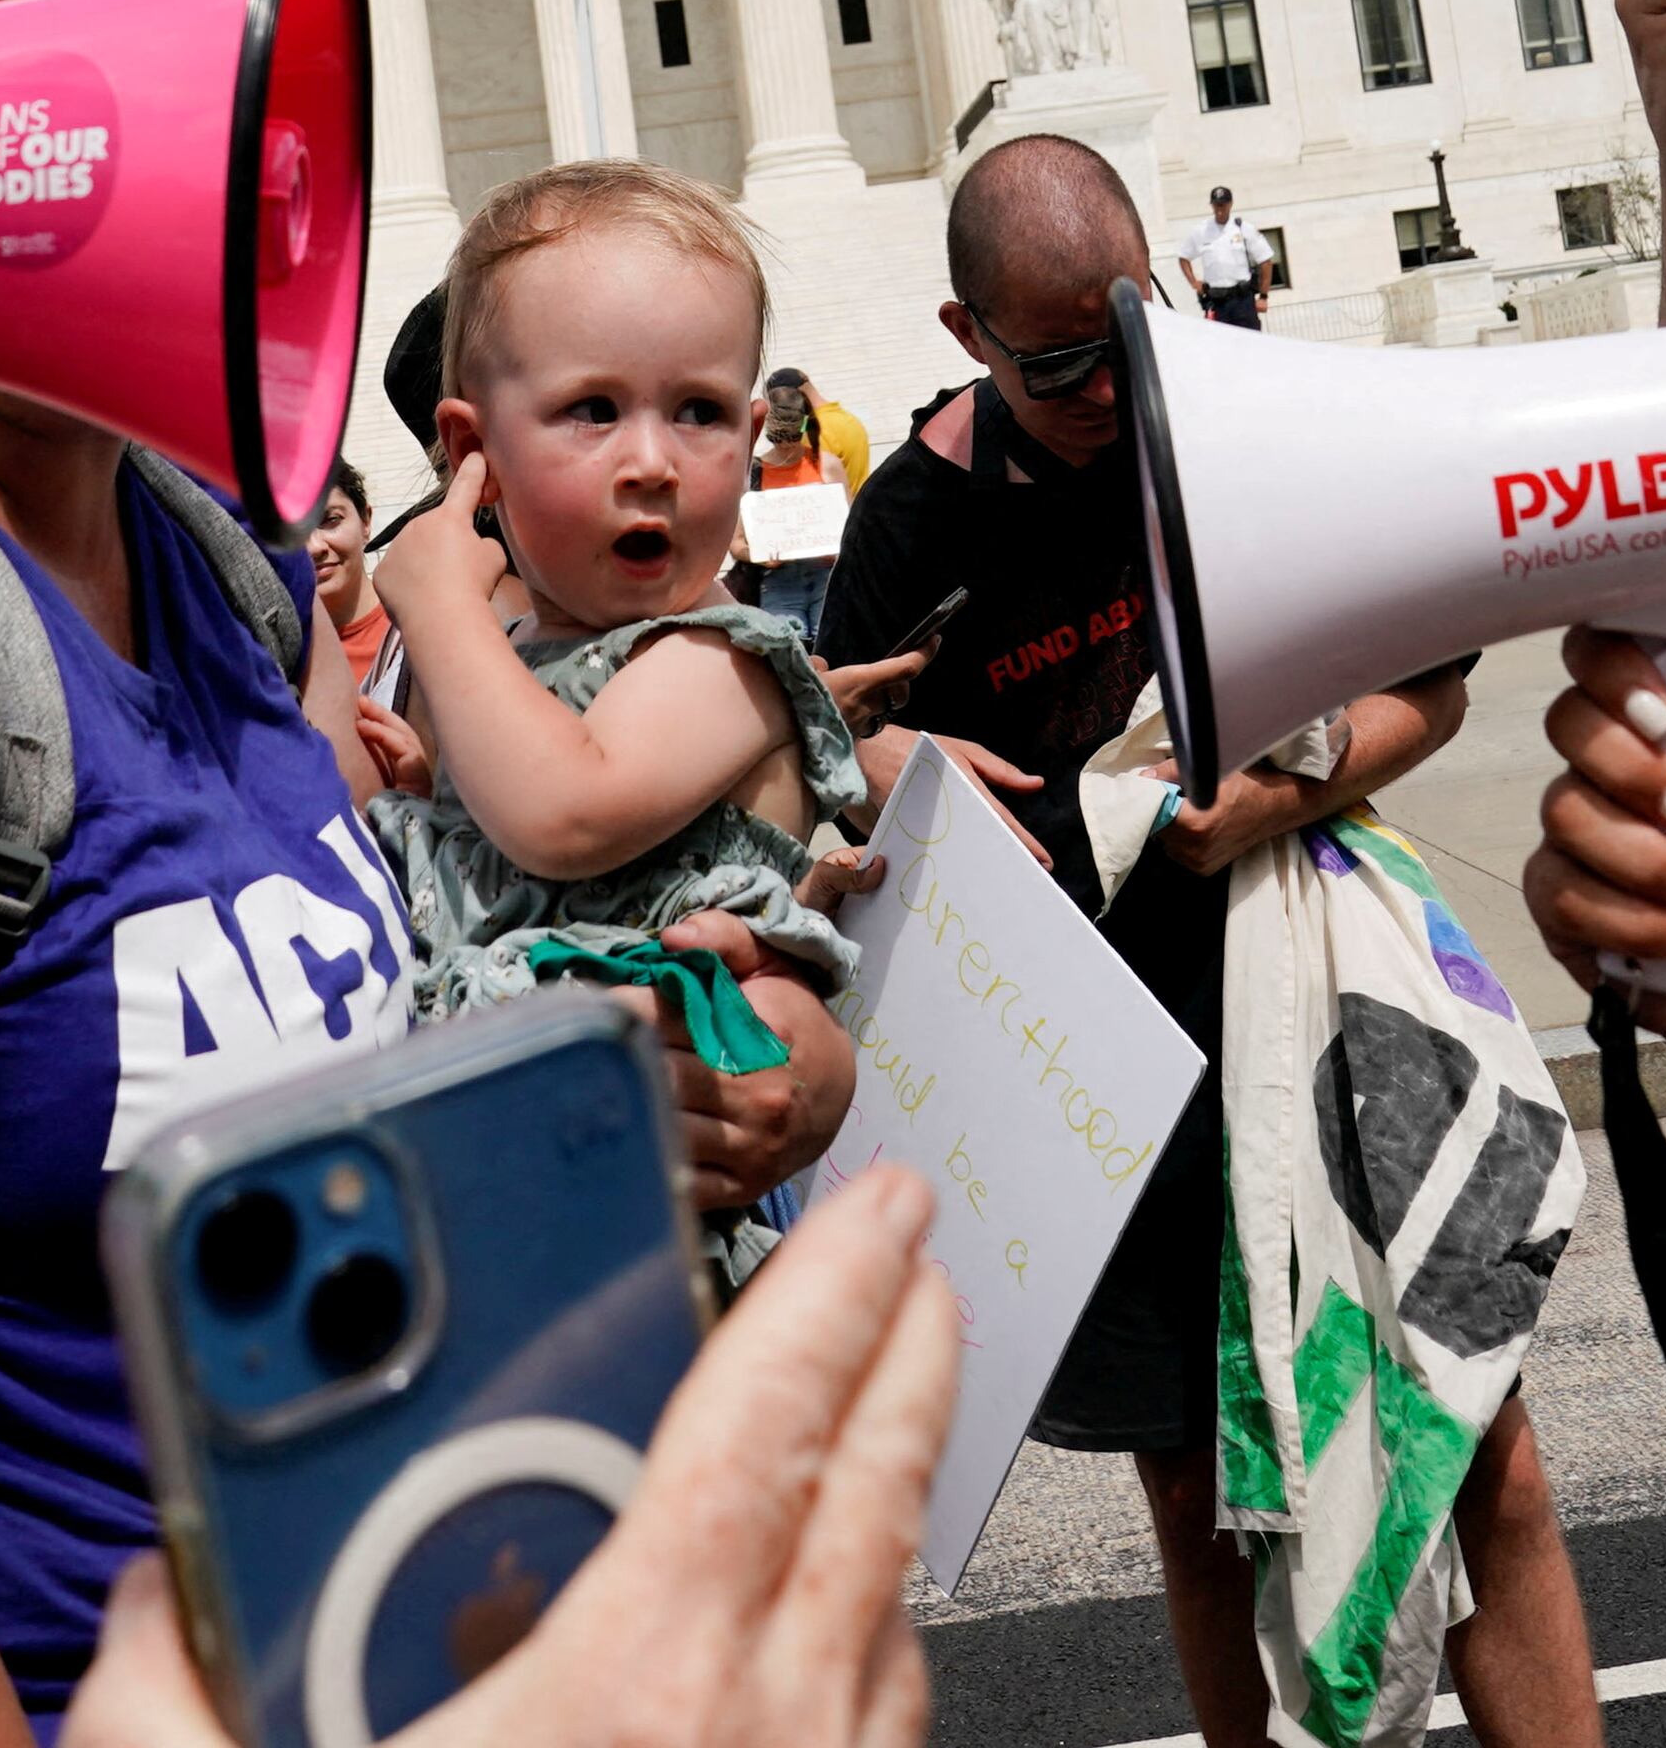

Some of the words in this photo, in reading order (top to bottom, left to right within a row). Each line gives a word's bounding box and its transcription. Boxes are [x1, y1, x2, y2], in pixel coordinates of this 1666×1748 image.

[19, 126, 109, 168] OUR
[986, 623, 1081, 694] FUND
[835, 967, 937, 1130] hould
[944, 1131, 990, 1224] be
[1004, 1239, 1030, 1291] a
